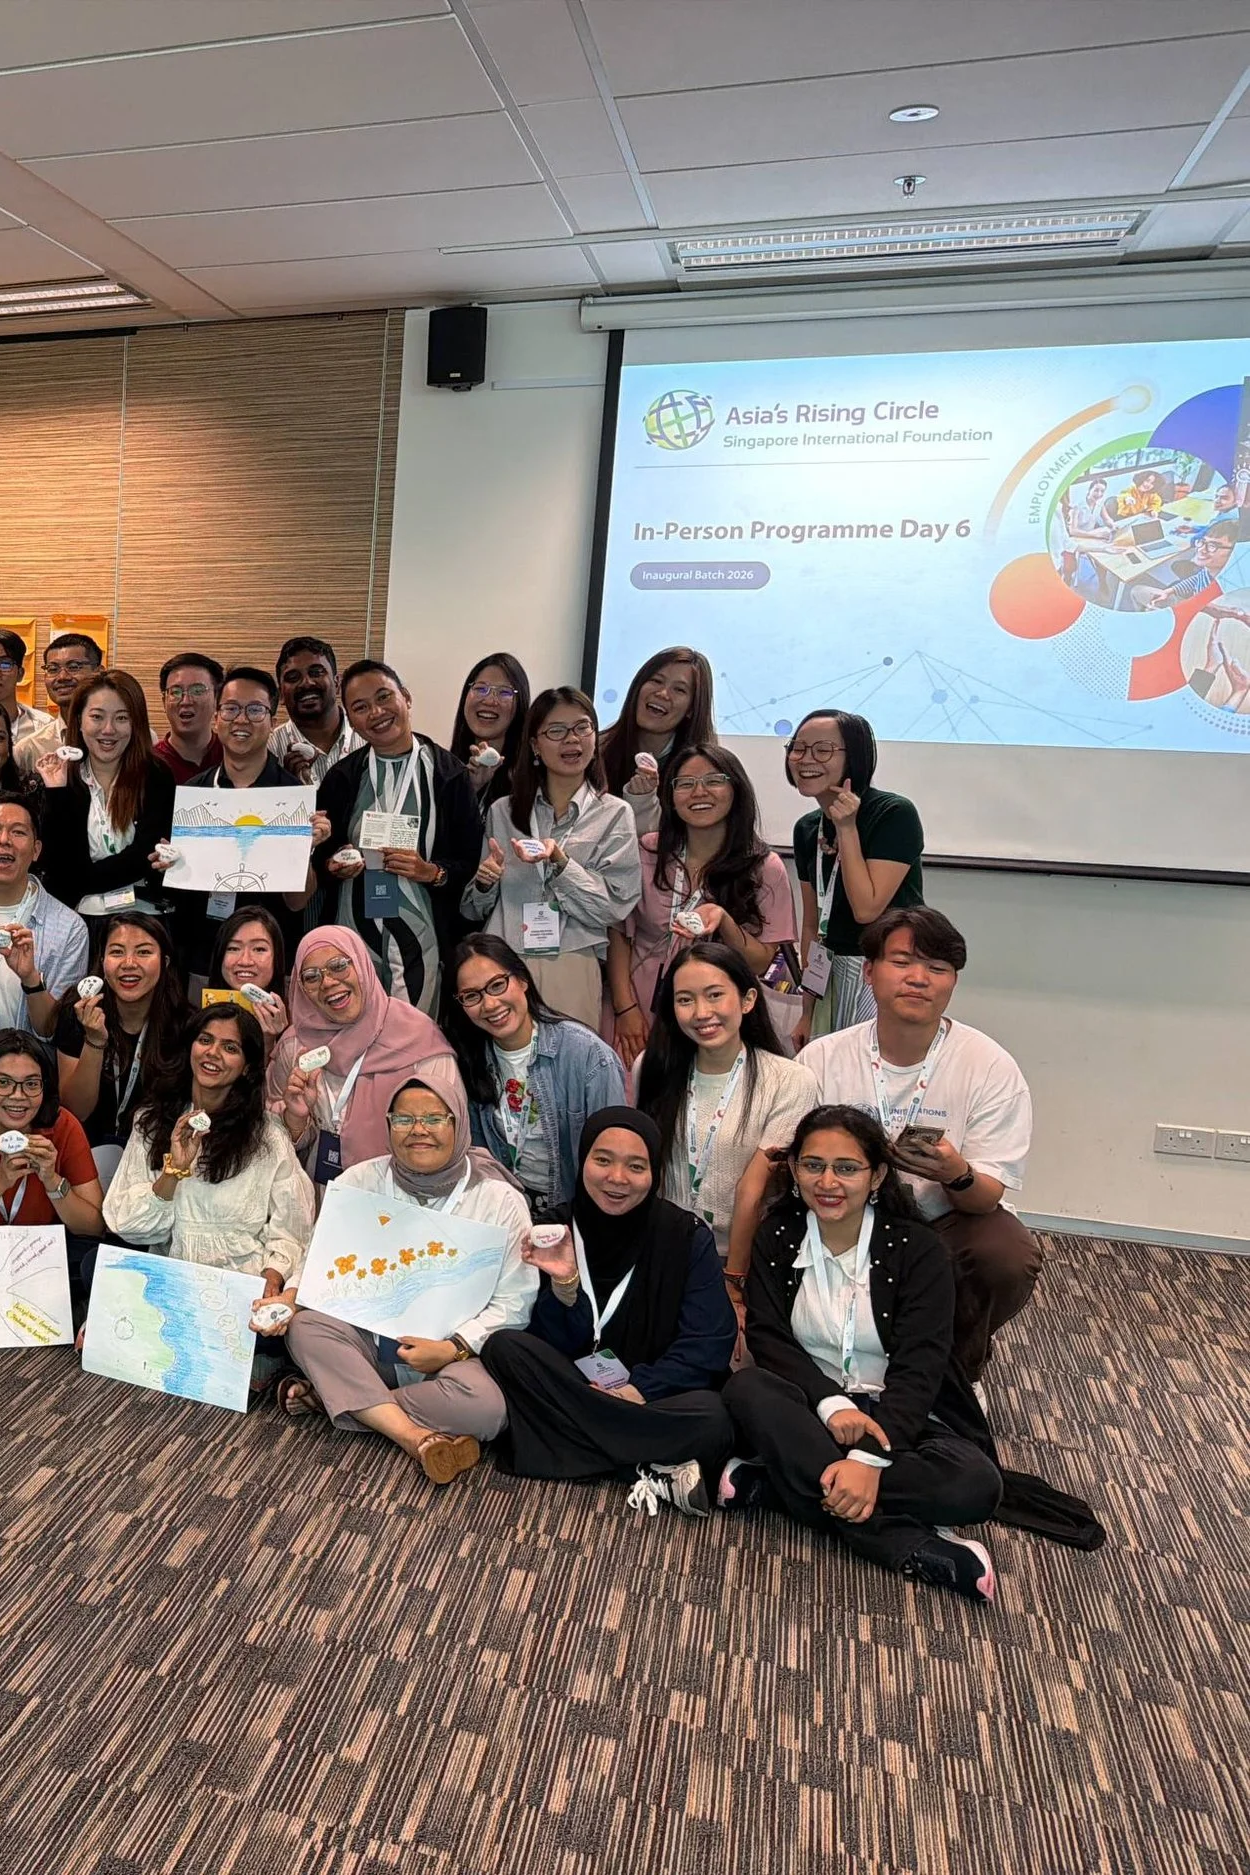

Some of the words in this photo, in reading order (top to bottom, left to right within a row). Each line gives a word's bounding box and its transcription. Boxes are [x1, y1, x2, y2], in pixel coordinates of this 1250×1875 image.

[725, 403, 788, 425] Asia's
[796, 403, 865, 425] Rising
[874, 400, 939, 420] Circle
[723, 435, 799, 450] Singapore
[803, 431, 898, 446] International
[903, 428, 993, 443] Foundation
[1028, 441, 1084, 525] EMPLOYMENT
[633, 521, 744, 541] In-Person
[750, 520, 894, 544] Programme
[900, 518, 950, 543] Day
[955, 519, 971, 538] 6
[642, 569, 693, 582] Inaugural
[695, 569, 725, 580] Batch
[727, 569, 754, 580] 2026
